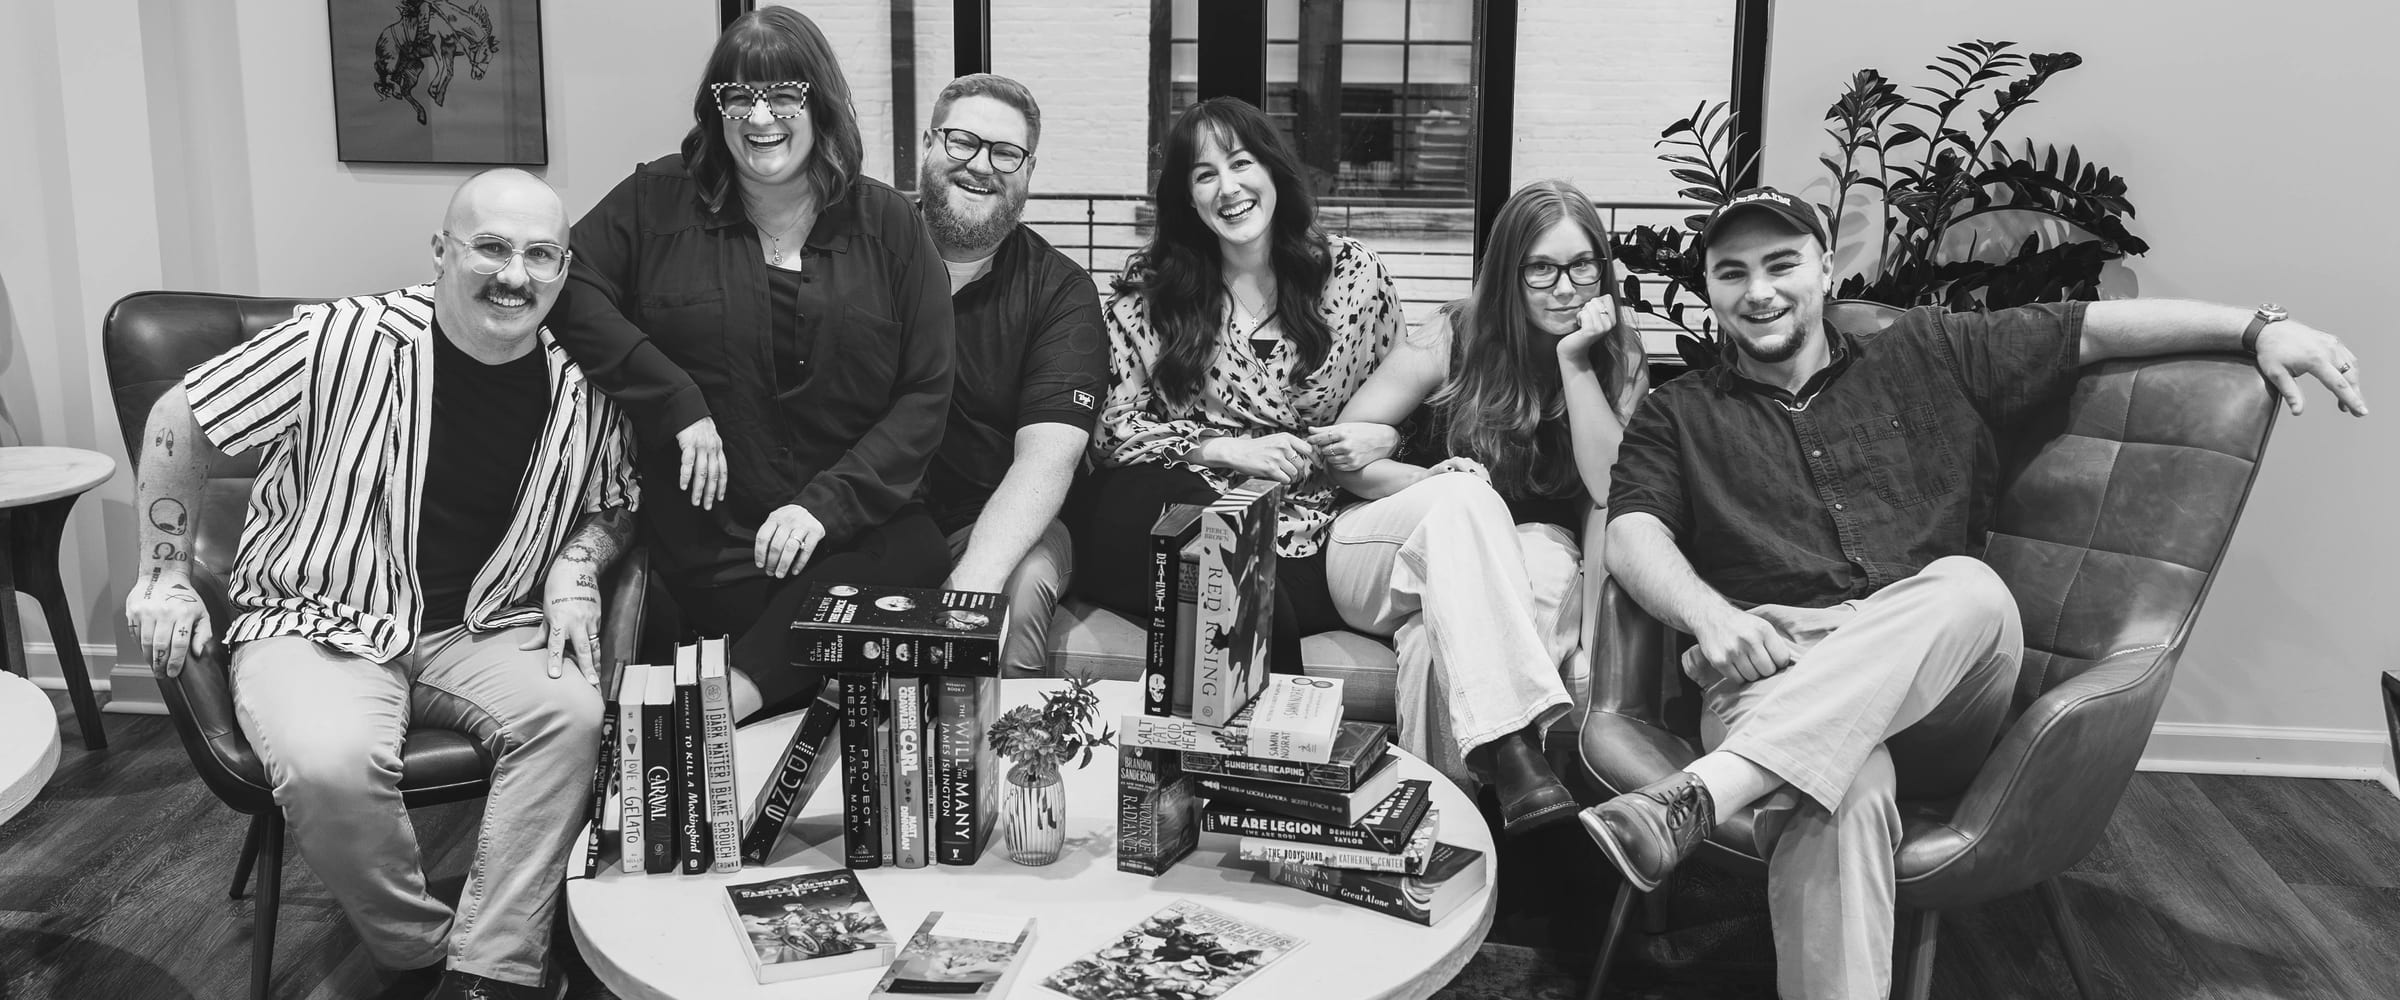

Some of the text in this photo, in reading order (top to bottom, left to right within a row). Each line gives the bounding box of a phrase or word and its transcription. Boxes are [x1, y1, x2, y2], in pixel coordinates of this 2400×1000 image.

[1204, 533, 1229, 542] BROWN
[1205, 567, 1223, 613] RED
[1202, 620, 1220, 697] RISING
[847, 684, 855, 728] WEIR
[859, 685, 868, 727] ANDY
[899, 686, 908, 729] CRAWLER
[907, 686, 917, 729] DUNGEON
[685, 735, 692, 748] TO
[955, 721, 970, 766] WILL
[1138, 720, 1152, 744] SALT
[1153, 723, 1167, 744] FAT
[1168, 724, 1181, 746] ACID
[1182, 722, 1197, 750] HEAT
[1269, 731, 1279, 757] SAMIN
[1280, 731, 1291, 759] NOSRAT
[686, 752, 694, 777] KILL
[899, 730, 919, 776] CARL
[1125, 756, 1152, 771] BRANDON
[624, 759, 641, 781] LOVE
[941, 722, 951, 817] JAMES ISLINGTON
[1120, 768, 1155, 784] SANDERSON
[1225, 760, 1259, 771] SUNRISE
[1268, 765, 1304, 776] REAPING
[647, 766, 670, 821] CARAVAL
[708, 714, 734, 858] DARK MATTER BLAKE CROUCH
[849, 744, 859, 833] HAIL MARY
[861, 749, 871, 827] PROJECT
[1246, 790, 1264, 798] LOCKE
[1265, 793, 1288, 801] LAMORA
[1309, 801, 1329, 809] LYNCH
[624, 796, 642, 844] GELATO
[684, 791, 700, 853] Mockingbird
[955, 782, 970, 840] MANY
[1123, 794, 1138, 852] RADIANCE
[909, 815, 917, 838] MATT
[1140, 802, 1152, 852] WORDS OF
[1219, 815, 1238, 827] WE
[1241, 817, 1267, 830] ARE
[1270, 820, 1322, 835] LEGION
[1329, 829, 1359, 837] DENNIS
[1334, 836, 1363, 845] TAYLOR
[1267, 848, 1403, 868] THE BODYGUARD KATHERINE CENTER
[1285, 862, 1328, 880] KRISTIN
[1284, 873, 1329, 892] HANNAH
[1341, 888, 1389, 908] Great Alone
